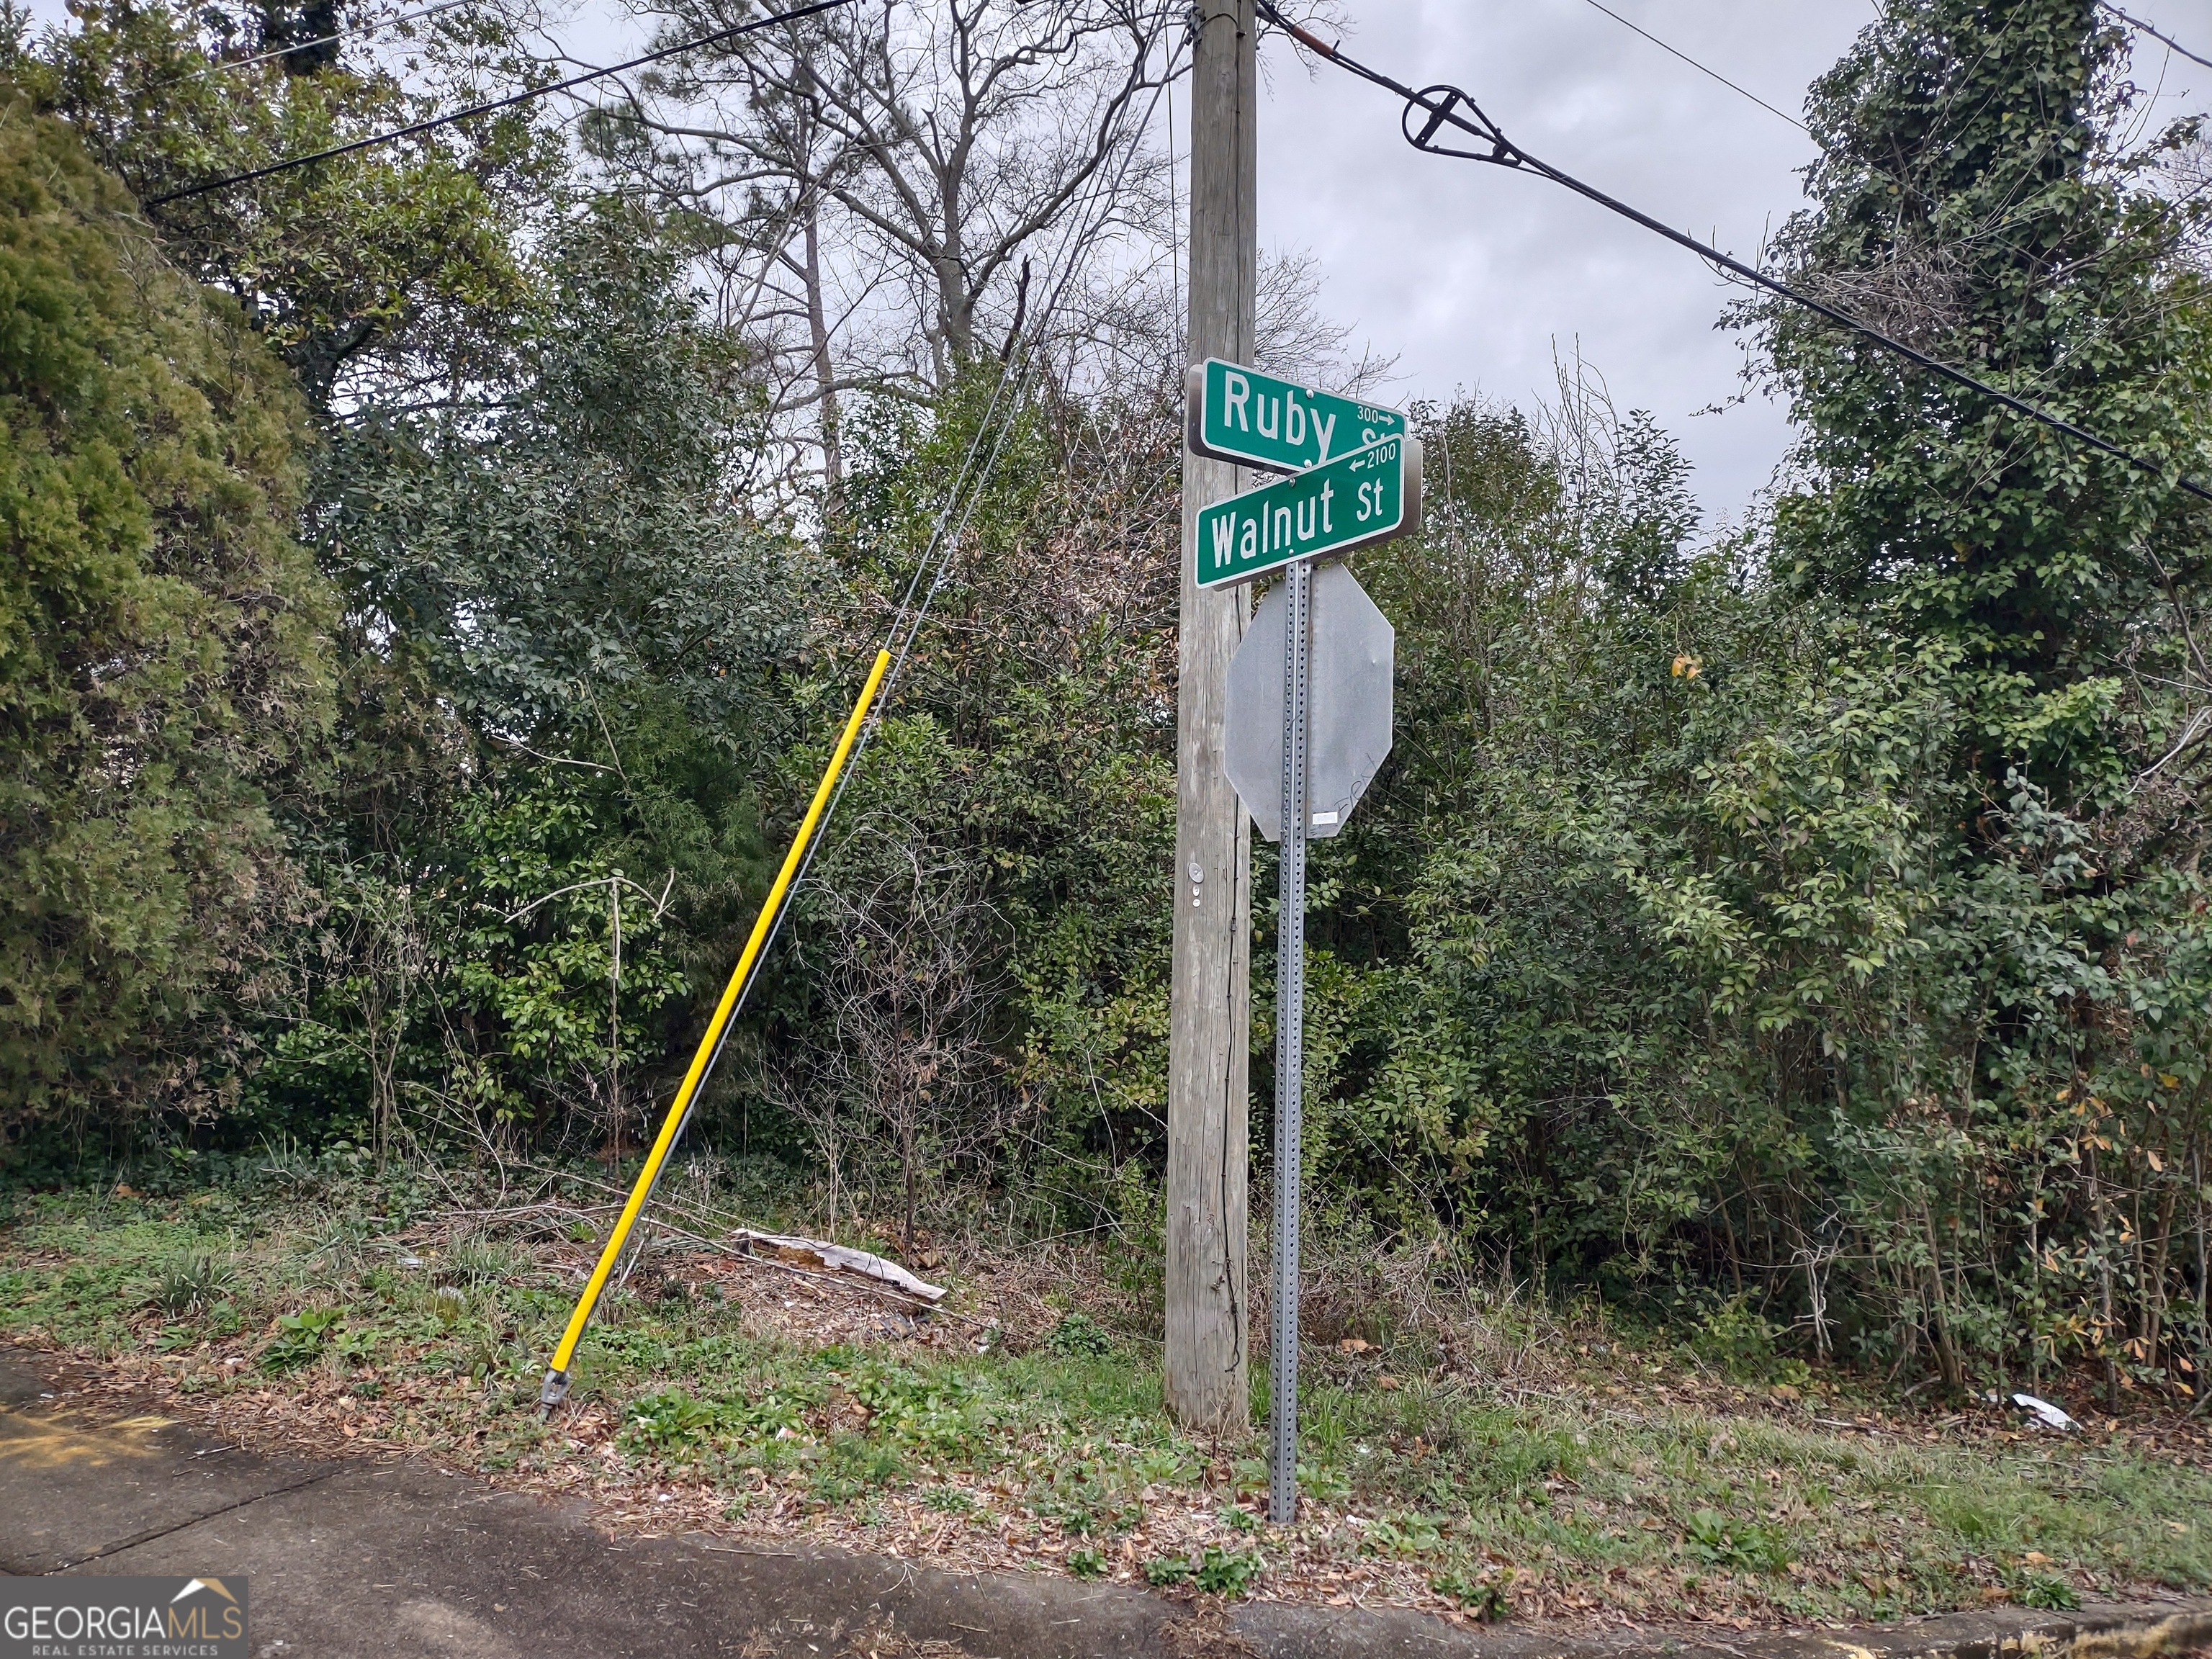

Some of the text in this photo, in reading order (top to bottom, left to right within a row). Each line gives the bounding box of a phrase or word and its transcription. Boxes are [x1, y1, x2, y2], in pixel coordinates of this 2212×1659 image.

[1224, 370, 1336, 464] Ruby
[1357, 405, 1378, 423] 300
[1367, 442, 1396, 469] 2100
[1212, 477, 1383, 568] Walnut St
